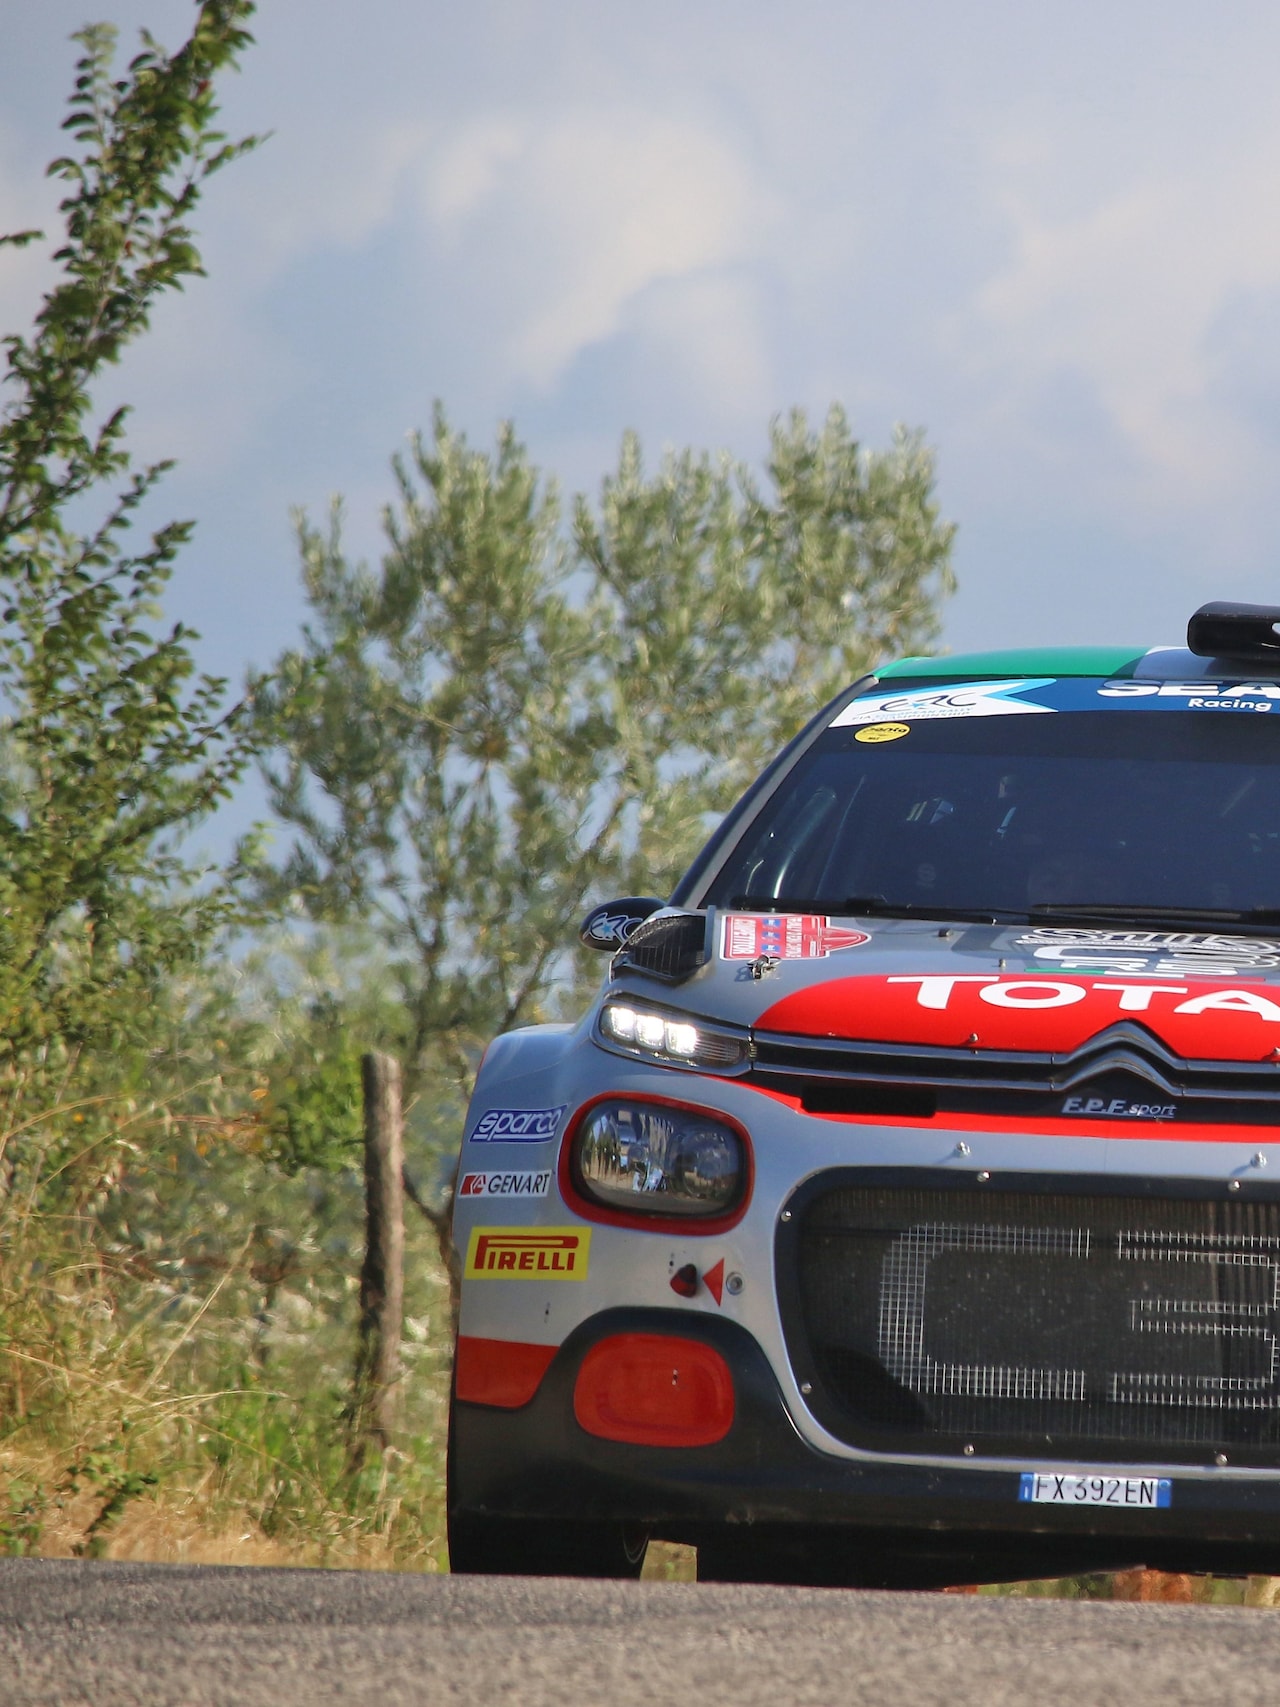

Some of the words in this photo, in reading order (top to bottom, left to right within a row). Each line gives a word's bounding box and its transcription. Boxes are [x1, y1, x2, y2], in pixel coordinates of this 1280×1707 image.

[1188, 697, 1272, 713] Racing
[474, 1108, 563, 1142] sparco
[488, 1174, 550, 1194] GENART
[474, 1235, 579, 1271] PIRELLI
